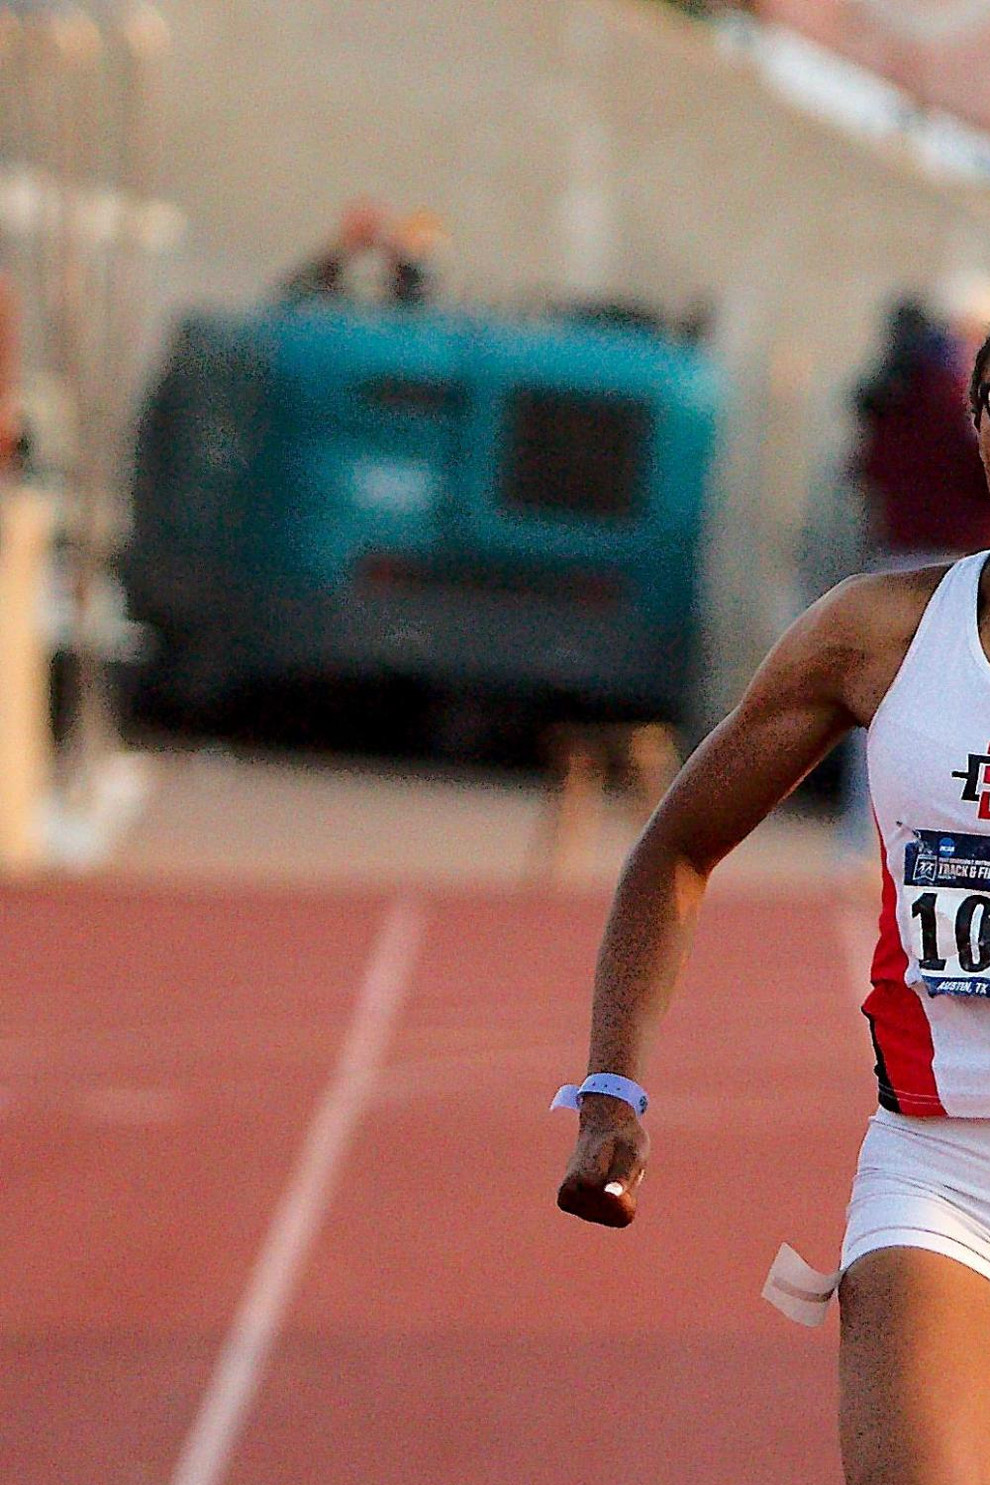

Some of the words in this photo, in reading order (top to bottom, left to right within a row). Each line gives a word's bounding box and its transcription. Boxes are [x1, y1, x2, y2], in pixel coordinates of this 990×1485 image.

[938, 862, 969, 878] TRACK
[969, 866, 977, 879] &
[975, 982, 989, 995] TX
